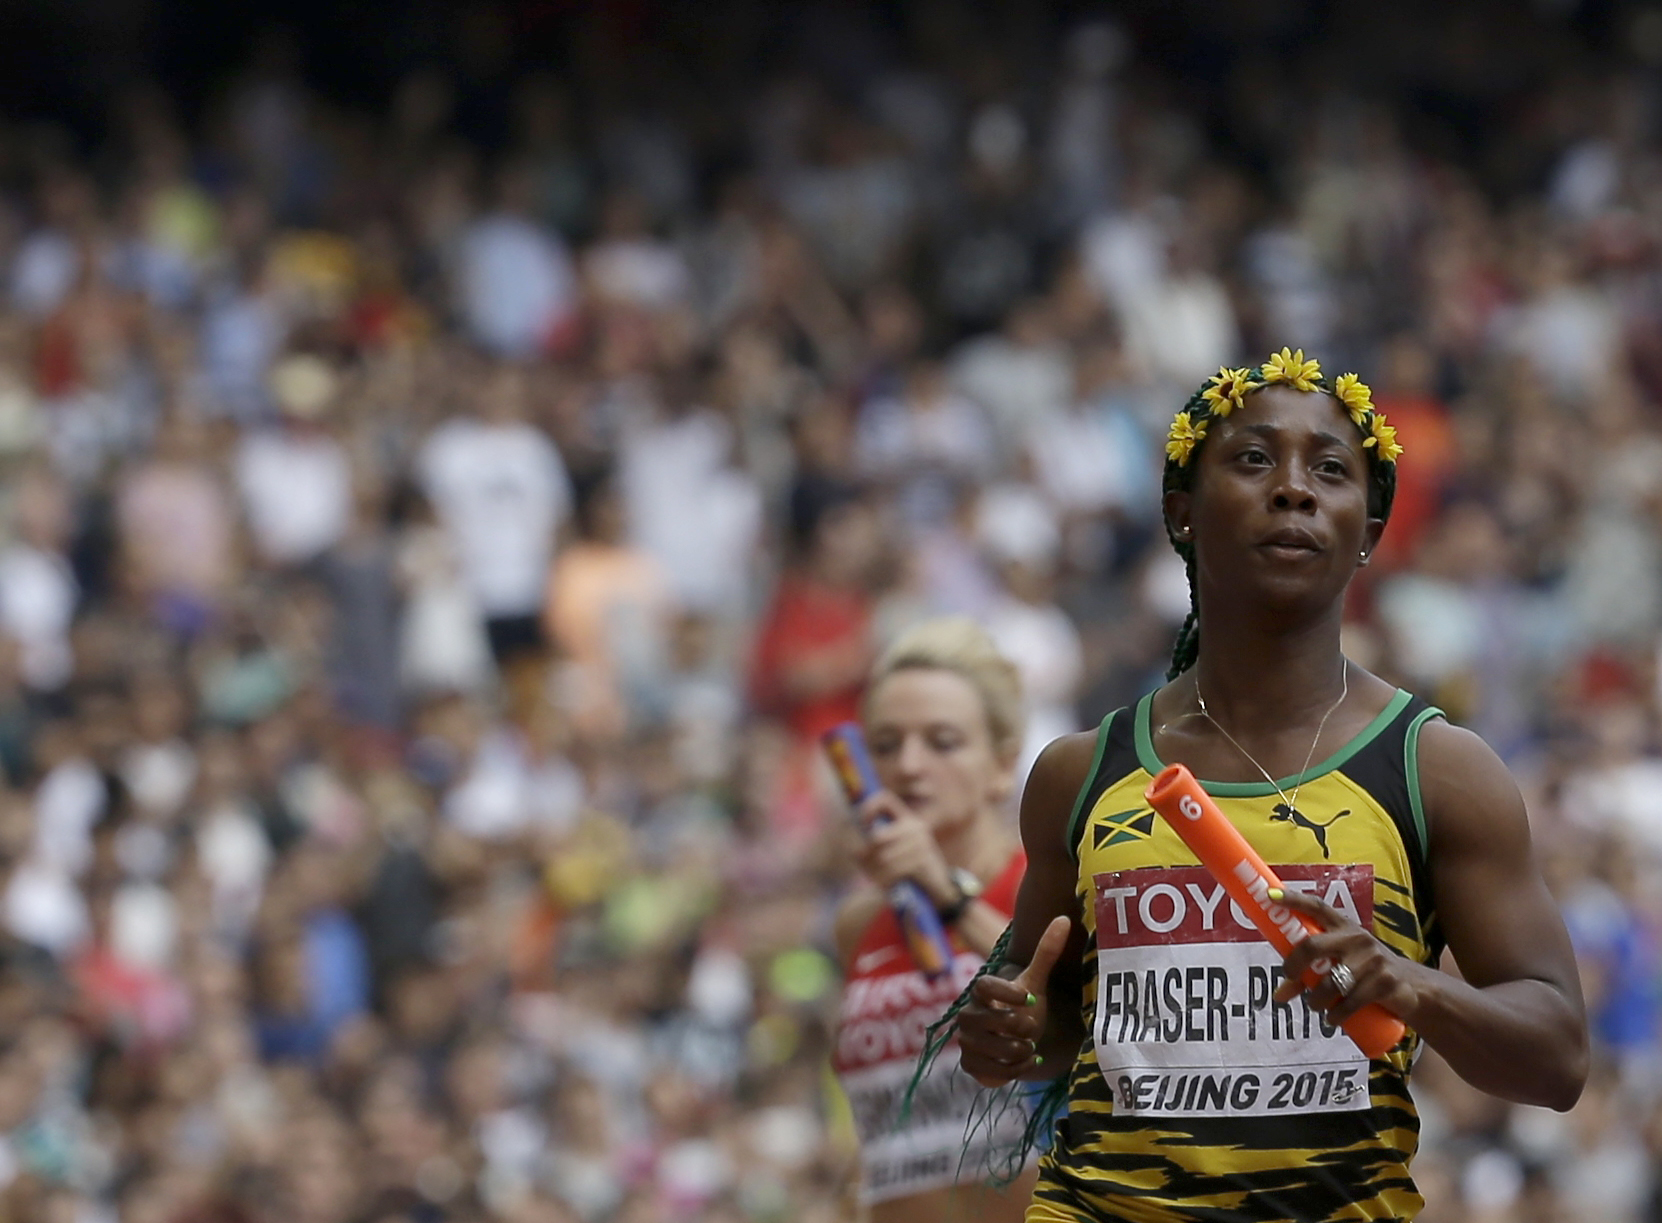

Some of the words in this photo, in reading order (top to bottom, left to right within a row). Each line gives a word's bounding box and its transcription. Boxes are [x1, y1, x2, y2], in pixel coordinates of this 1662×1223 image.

[1179, 794, 1203, 821] 6
[1104, 880, 1362, 935] TOYA
[1101, 965, 1347, 1045] FRASER-PRY
[1117, 1072, 1260, 1111] BEIJING
[1267, 1068, 1359, 1109] 2015
